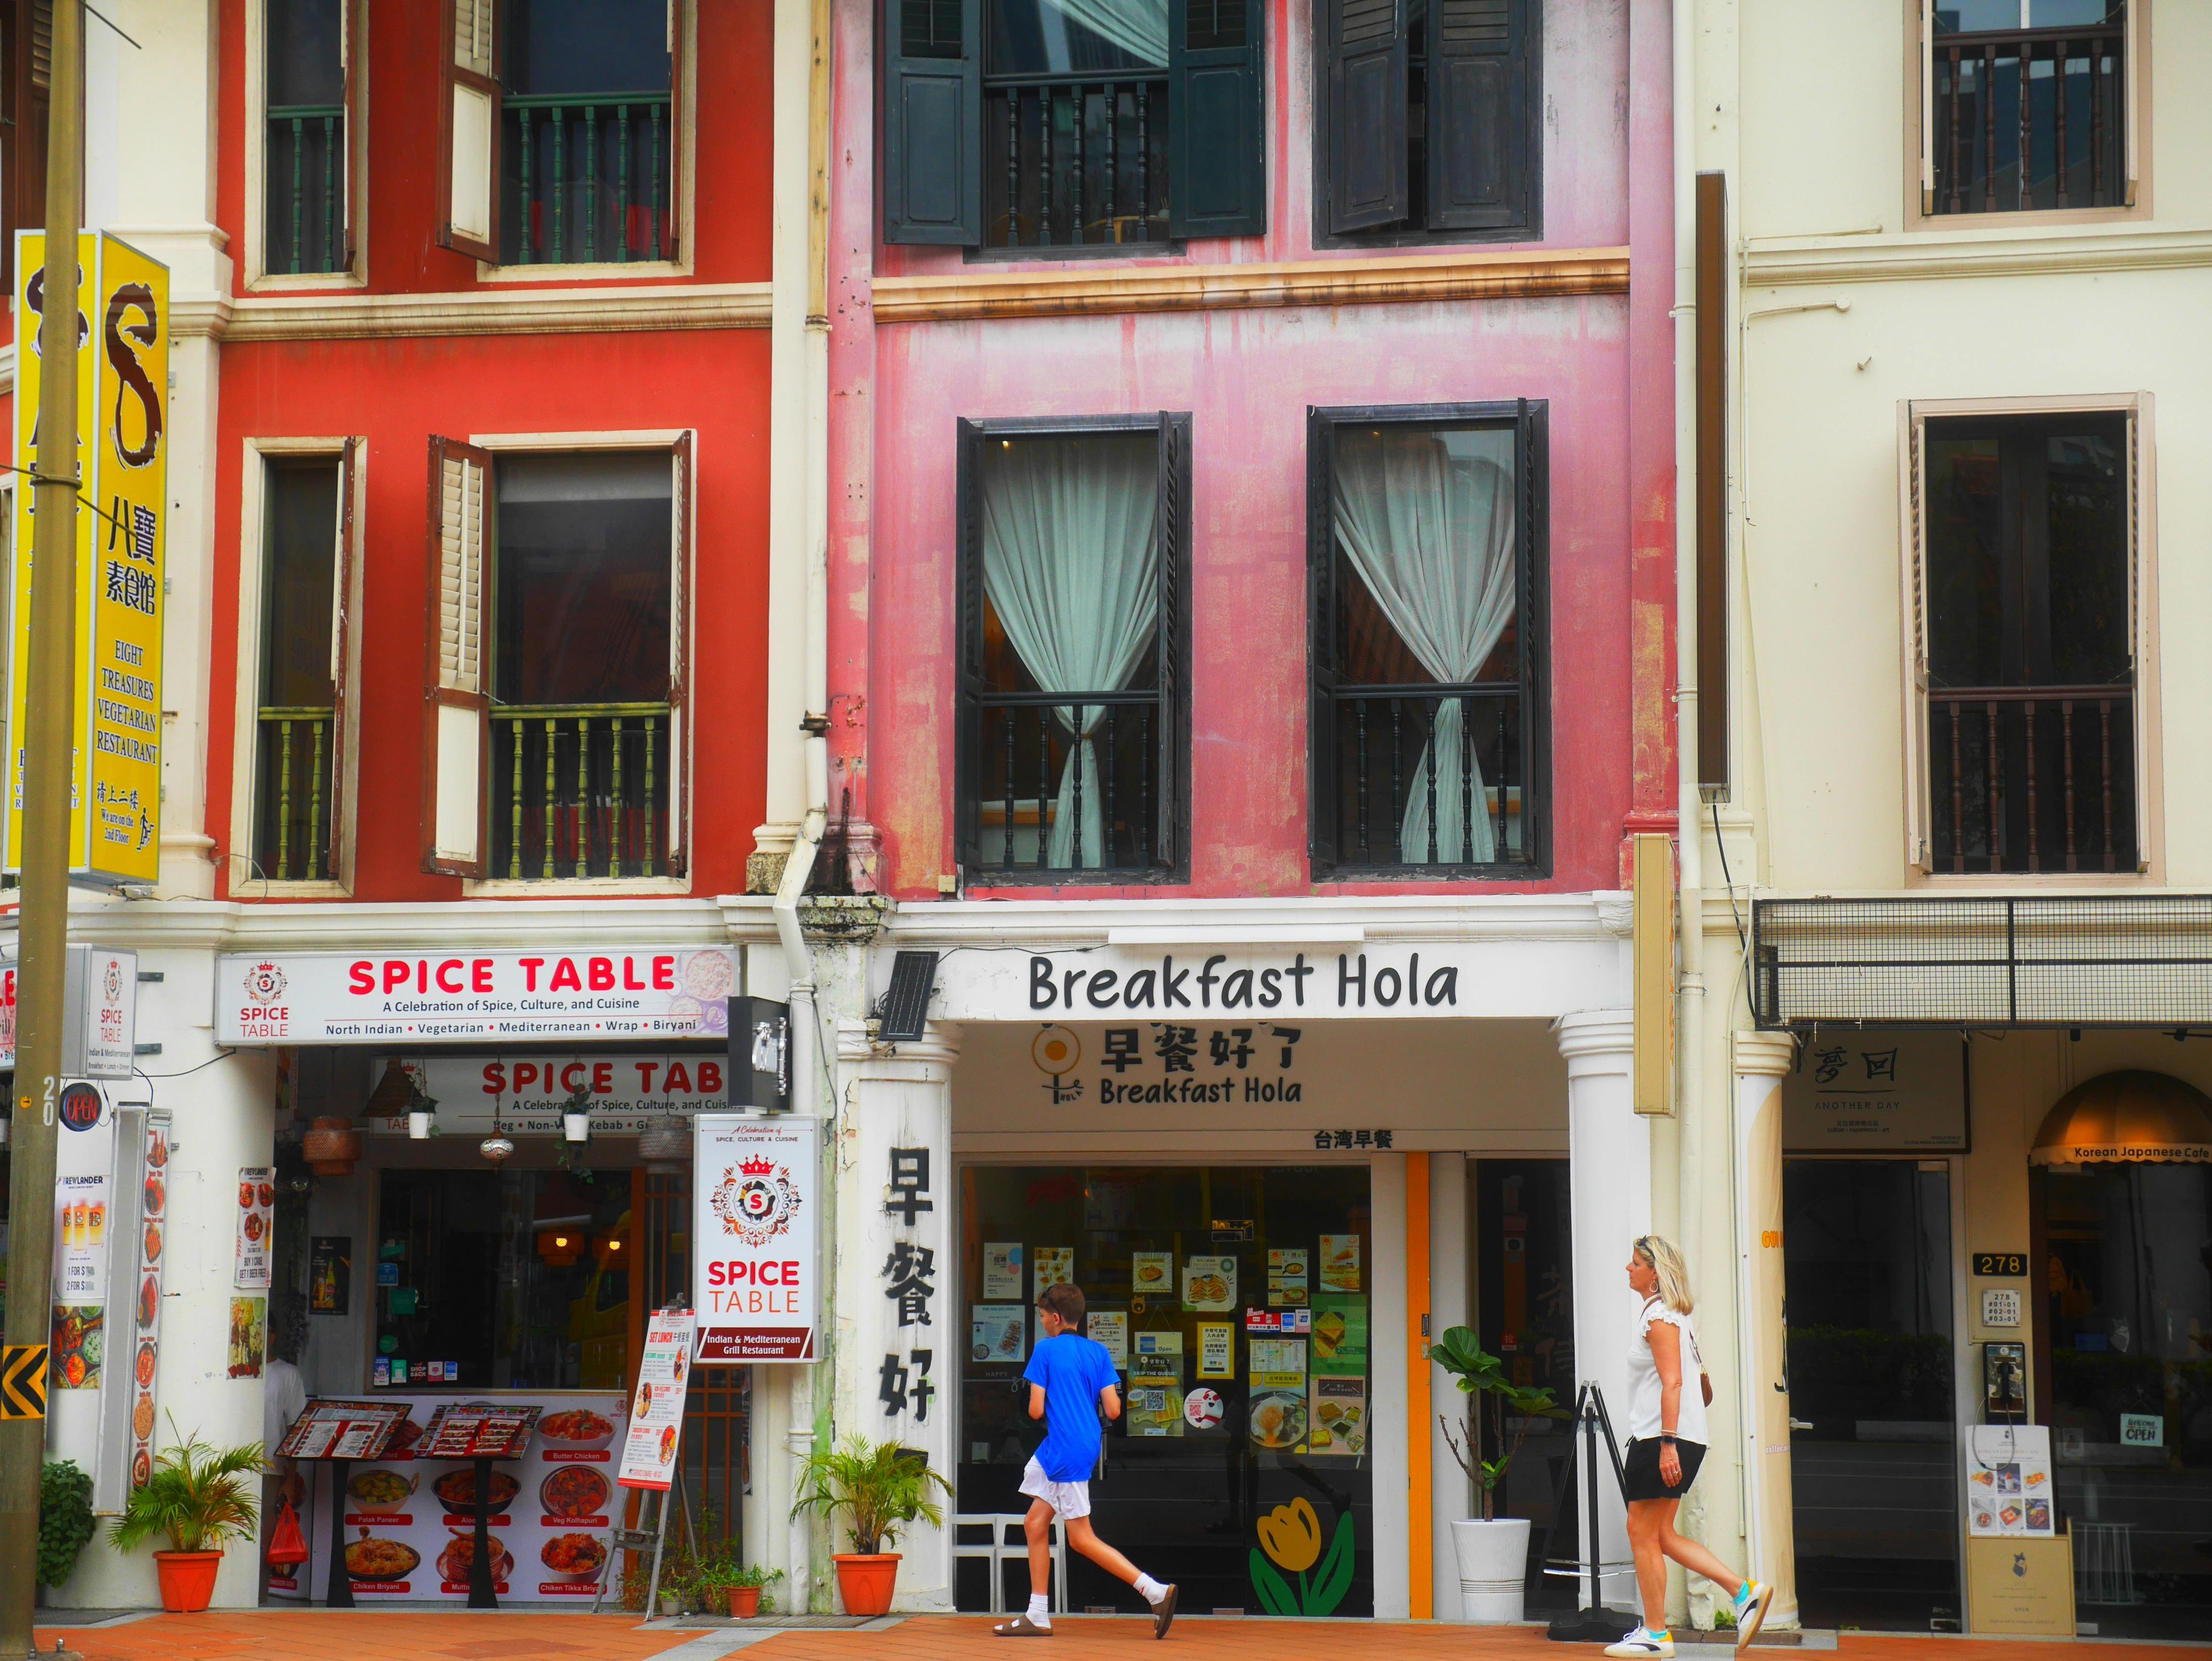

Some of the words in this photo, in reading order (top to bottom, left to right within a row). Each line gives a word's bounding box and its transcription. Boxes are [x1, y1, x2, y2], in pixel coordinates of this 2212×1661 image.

[115, 639, 144, 666] EIGHT
[102, 668, 154, 701] TREASURES
[97, 699, 156, 733] VEGETARIAN
[96, 730, 157, 765] RESTAURANT
[101, 807, 110, 821] We
[109, 812, 118, 824] are
[118, 815, 125, 825] on
[125, 814, 134, 828] the
[104, 827, 114, 841] 2nd
[115, 828, 129, 844] Floor
[349, 959, 494, 995] SPICE
[518, 955, 674, 992] TABLE
[1029, 953, 1307, 1010] Breakfast
[1337, 952, 1458, 1007] Hola
[383, 1002, 391, 1012] A
[395, 1001, 463, 1012] Celebration
[467, 1000, 479, 1011] of
[482, 999, 517, 1013] Spice,
[521, 999, 567, 1011] Culture,
[571, 998, 593, 1009] and
[597, 998, 640, 1009] Cuisine
[101, 1009, 122, 1024] SPICE
[240, 1007, 289, 1021] SPICE
[239, 1024, 289, 1037] TABLE
[326, 1024, 361, 1035] North
[365, 1023, 403, 1034] Indian
[418, 1022, 484, 1035] Vegetarian
[499, 1021, 590, 1032] Mediterranean
[606, 1020, 638, 1033] Wrap
[653, 1018, 696, 1033] Biryani
[100, 1028, 121, 1042] TABLE
[89, 1048, 100, 1056] Indian
[100, 1048, 104, 1056] &
[105, 1048, 131, 1058] Mediterranean
[1100, 1025, 1302, 1073] 早餐好了
[482, 1062, 613, 1094] SPICE
[1100, 1077, 1232, 1105] Breakfast
[1244, 1076, 1302, 1103] Hola
[67, 1094, 97, 1122] OPEN
[513, 1101, 521, 1110] A
[602, 1100, 633, 1111] Spice,
[636, 1100, 678, 1111] Culture,
[682, 1100, 701, 1110] and
[1815, 1101, 1871, 1110] ANOTHER
[1877, 1101, 1900, 1110] DAY
[740, 1125, 774, 1134] Celebration
[774, 1125, 782, 1136] of
[1314, 1130, 1392, 1149] 台湾早餐
[2074, 1147, 2118, 1157] Korean
[2120, 1147, 2182, 1158] Japanese
[2185, 1147, 2209, 1158] Cafe
[750, 1193, 762, 1210] S
[71, 1266, 80, 1276] FOR
[1981, 1256, 2020, 1273] 278
[708, 1261, 800, 1286] SPICE
[71, 1281, 80, 1291] FOR
[709, 1291, 799, 1313] TABLE
[649, 1332, 658, 1343] SET
[658, 1332, 673, 1343] LUNCH
[707, 1335, 733, 1344] Indian
[735, 1335, 741, 1344] &
[743, 1335, 800, 1344] Mediterranean
[723, 1346, 740, 1355] Grill
[742, 1346, 784, 1355] Restaurant
[2128, 1418, 2155, 1426] Welcome
[2126, 1428, 2155, 1441] OPEN
[376, 1516, 399, 1524] Paneer
[553, 1516, 565, 1526] Veg
[566, 1516, 597, 1526] Kolhapuri
[353, 1583, 375, 1591] Chiken
[376, 1583, 400, 1593] Briyani
[451, 1583, 470, 1591] Mutto
[540, 1583, 562, 1592] Chiken
[564, 1583, 582, 1592] Tikka
